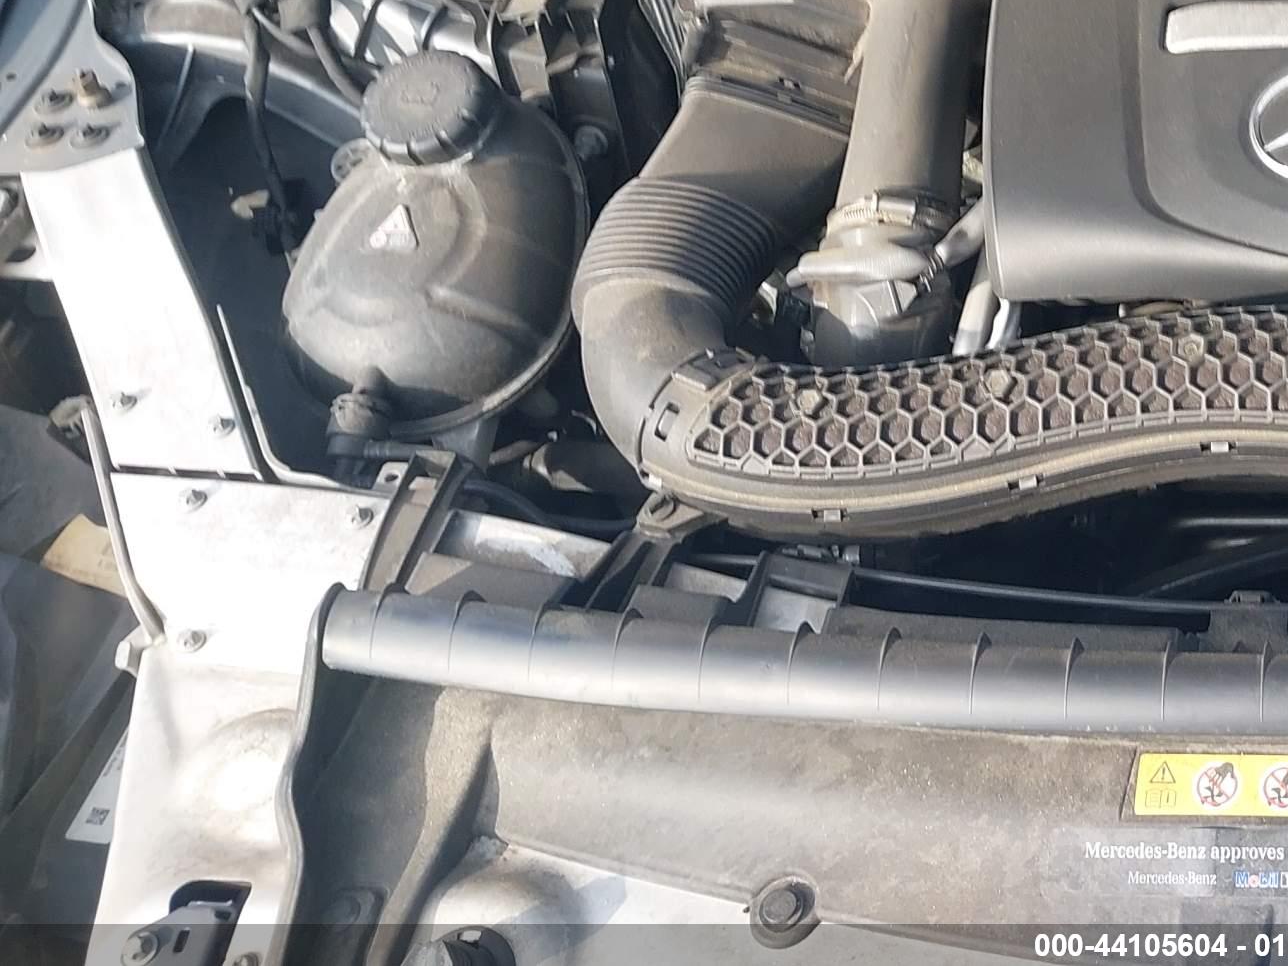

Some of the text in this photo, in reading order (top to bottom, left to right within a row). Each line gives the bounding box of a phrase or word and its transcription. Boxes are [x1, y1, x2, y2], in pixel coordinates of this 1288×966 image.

[1085, 841, 1207, 859] Mercedes-Benz
[1210, 845, 1285, 864] approves
[1128, 870, 1218, 886] Mercedes-Benz
[1234, 870, 1279, 889] Mobil
